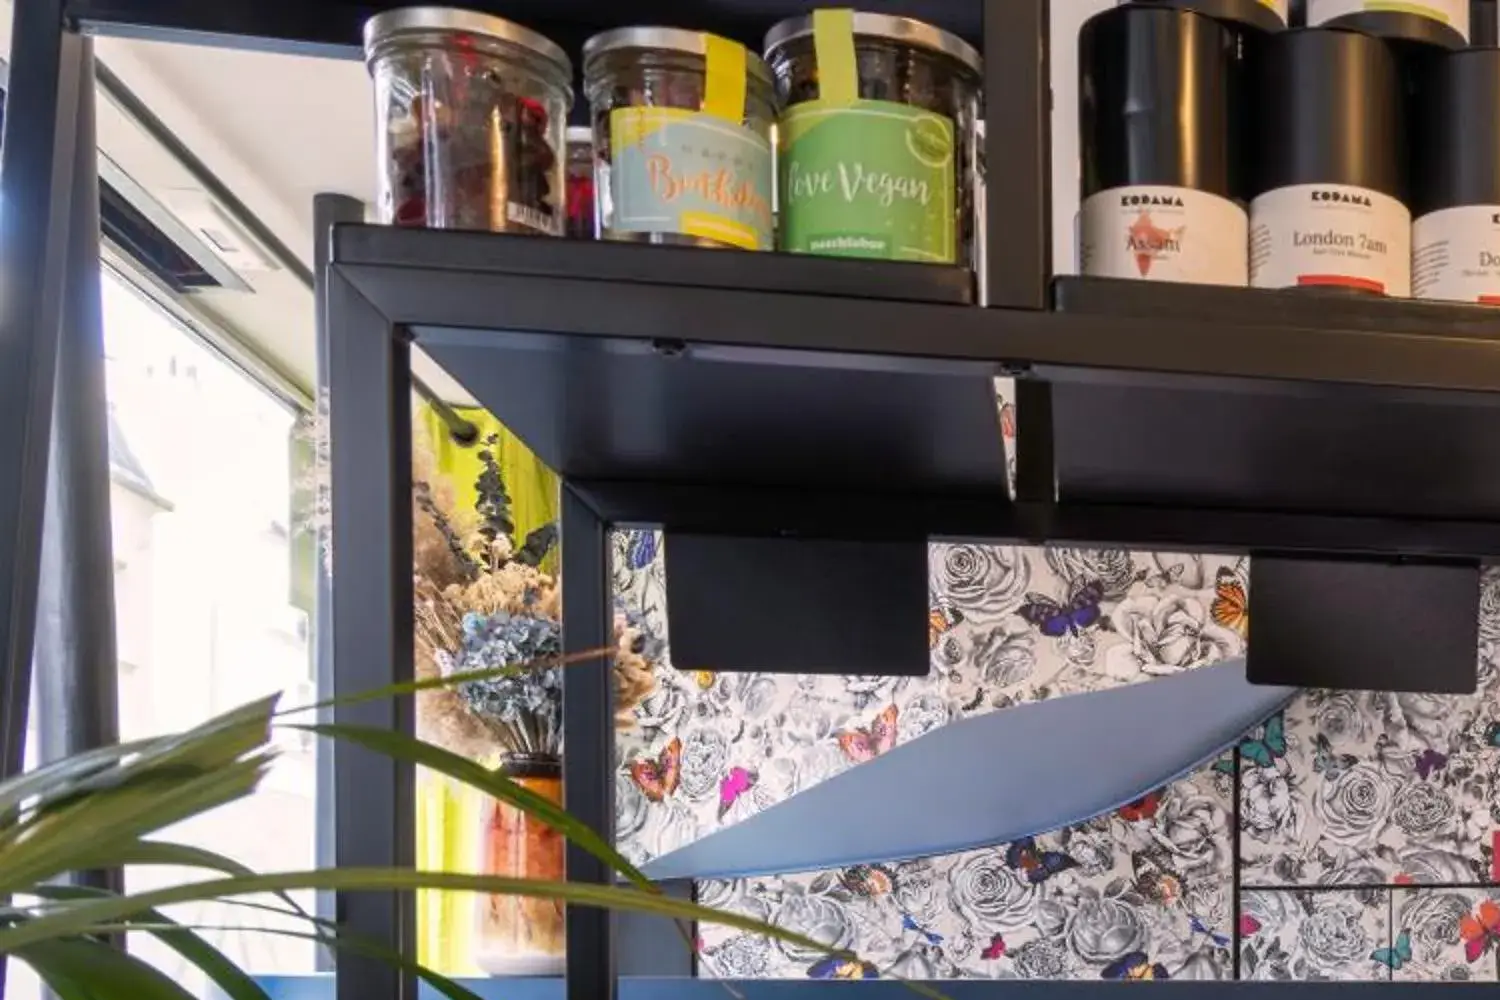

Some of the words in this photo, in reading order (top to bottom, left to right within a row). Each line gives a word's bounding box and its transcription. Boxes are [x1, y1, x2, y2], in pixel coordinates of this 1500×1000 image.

[837, 160, 933, 208] Vegan
[1120, 194, 1185, 208] KODAMA
[1310, 190, 1373, 207] KODAMA
[1293, 229, 1355, 248] London
[1360, 233, 1388, 254] 7am
